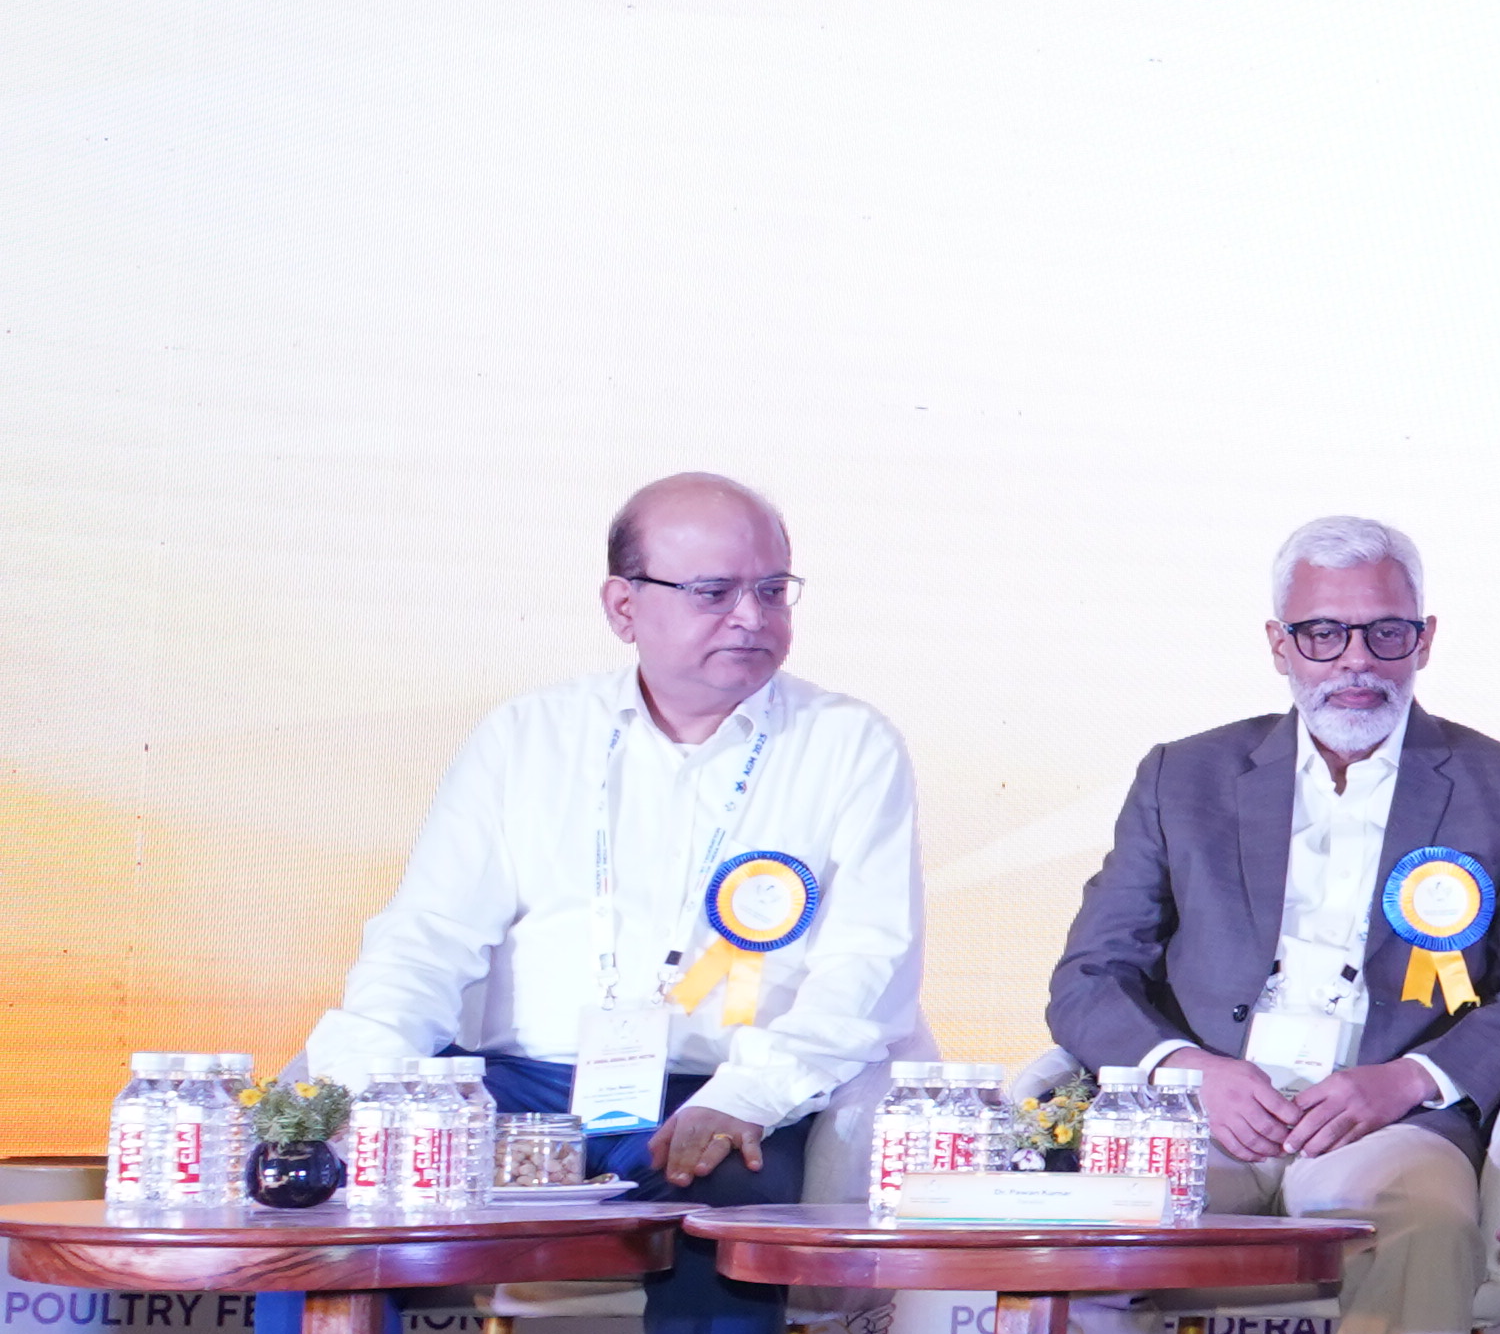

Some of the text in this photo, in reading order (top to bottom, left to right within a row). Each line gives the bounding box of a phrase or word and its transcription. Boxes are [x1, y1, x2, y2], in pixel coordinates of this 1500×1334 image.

[752, 732, 768, 755] 2025
[1042, 1188, 1072, 1197] Kumar
[4, 1291, 204, 1327] POULTRY
